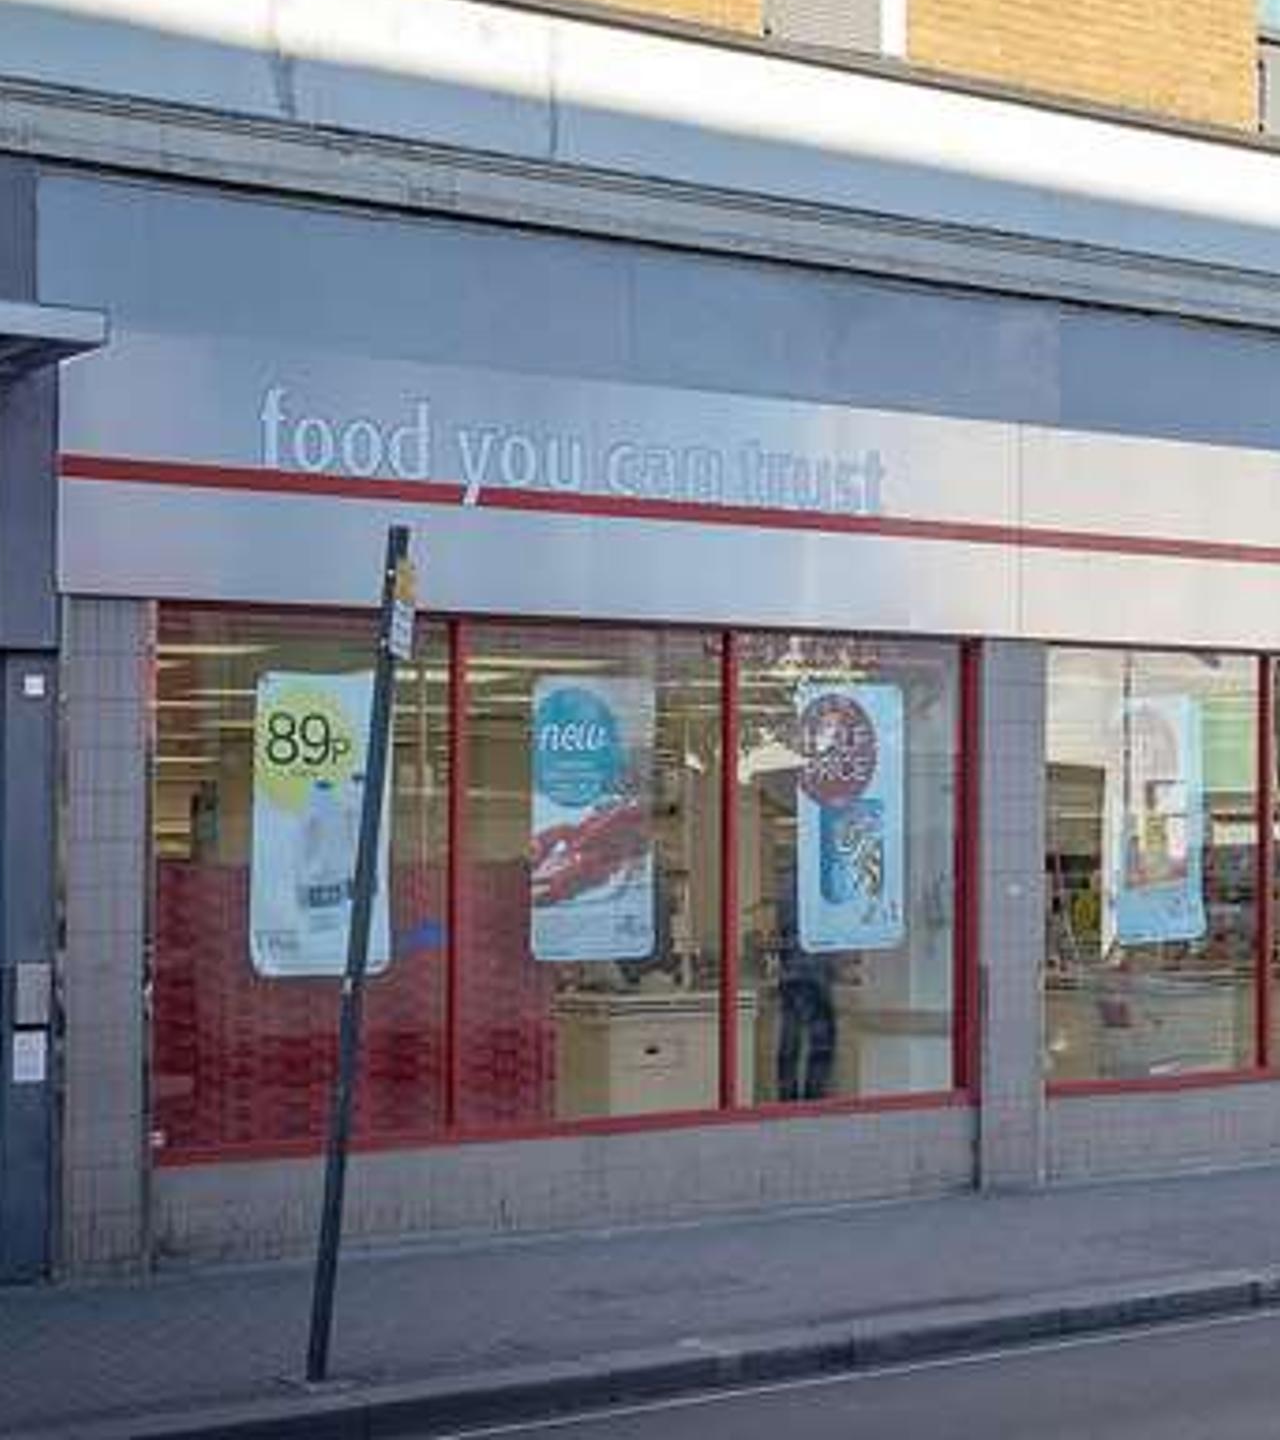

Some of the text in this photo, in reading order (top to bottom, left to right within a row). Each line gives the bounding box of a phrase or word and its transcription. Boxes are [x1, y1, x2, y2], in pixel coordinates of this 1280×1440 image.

[261, 388, 430, 479] food
[457, 426, 581, 506] you
[608, 442, 720, 503] can
[539, 720, 607, 751] new
